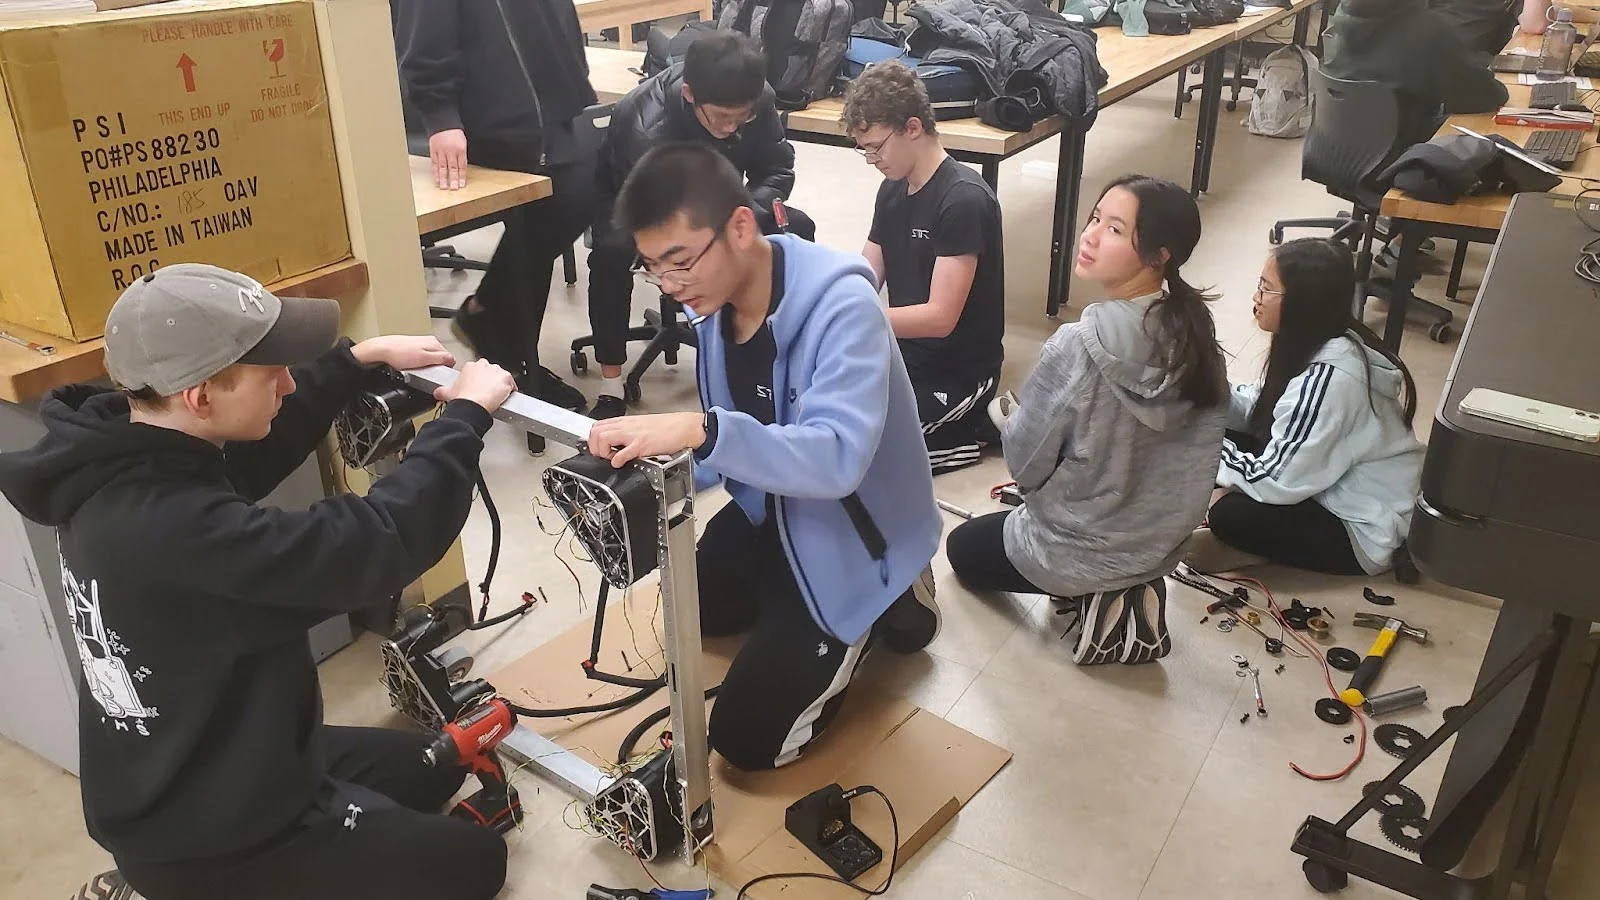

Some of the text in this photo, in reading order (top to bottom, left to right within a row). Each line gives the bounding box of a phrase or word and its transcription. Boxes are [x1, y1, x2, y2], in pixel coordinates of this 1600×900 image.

[142, 14, 293, 43] PLEASE HANDLE WITH CARE
[261, 83, 301, 101] FRAGILE
[158, 102, 230, 126] THIS END UP
[251, 108, 265, 123] DO
[268, 104, 287, 119] NOT
[88, 156, 223, 204] PHILADELPHIA
[177, 187, 206, 215] 185
[104, 206, 253, 262] MADE IN TAIWAN
